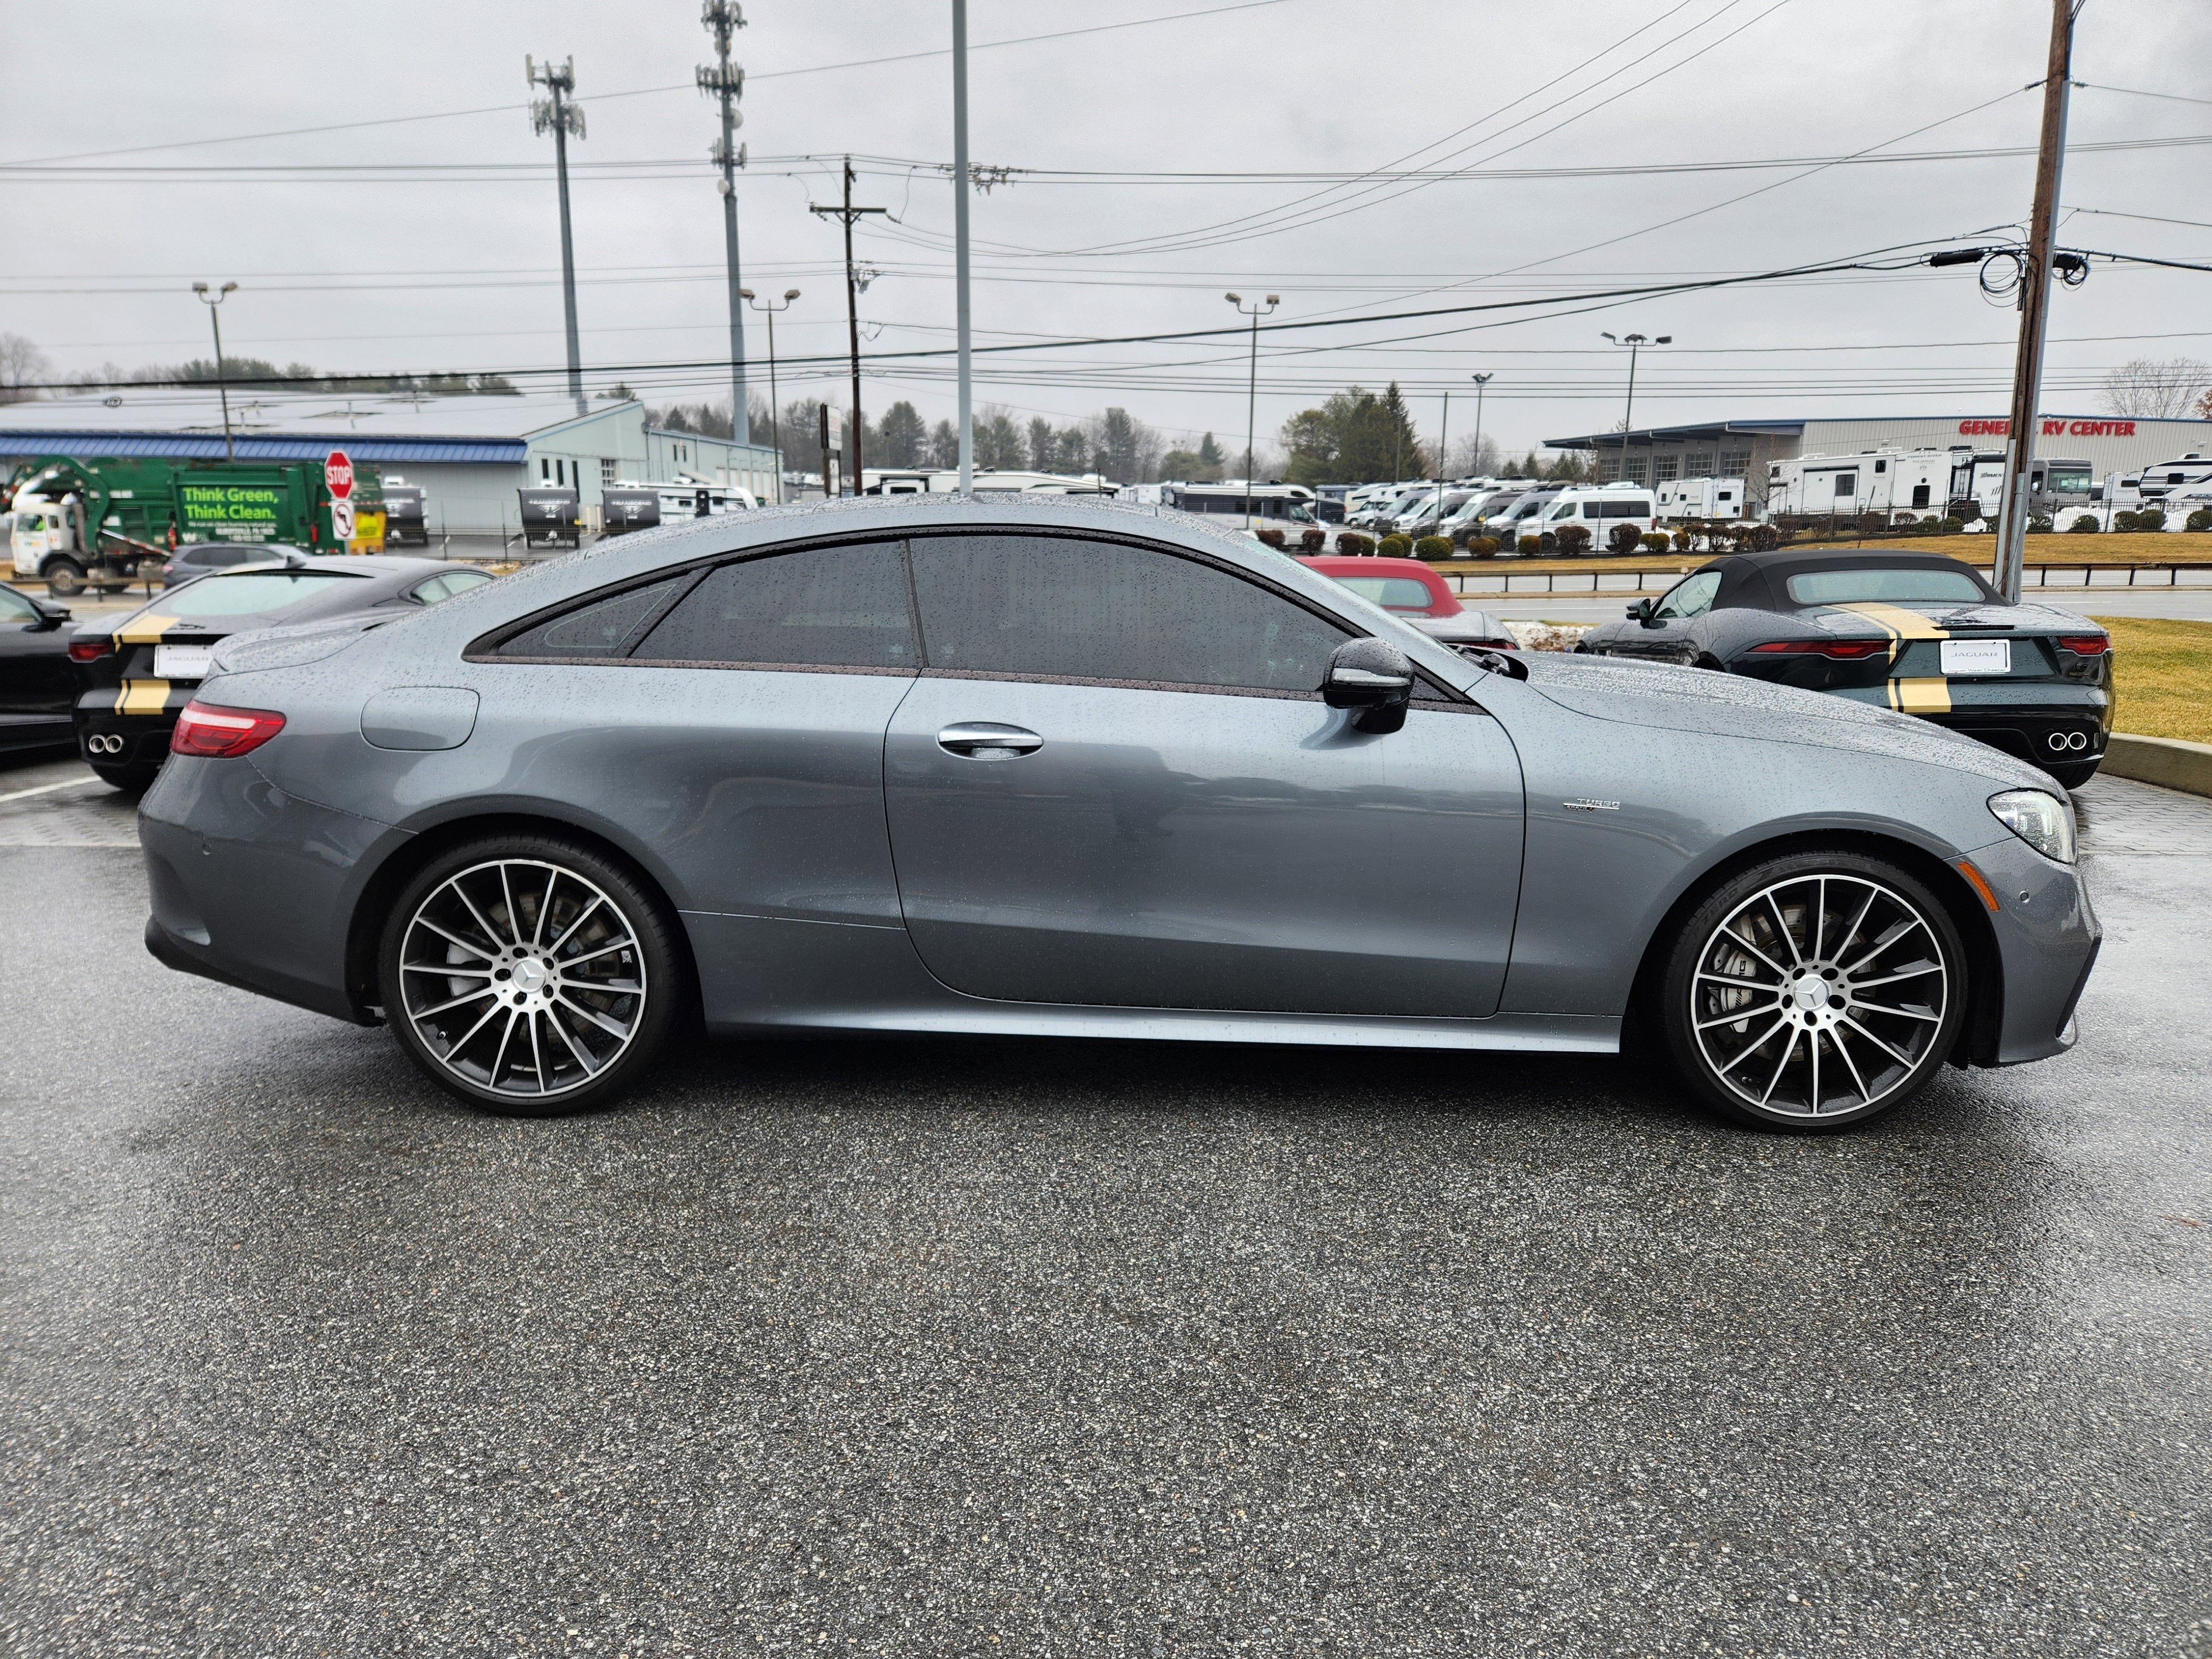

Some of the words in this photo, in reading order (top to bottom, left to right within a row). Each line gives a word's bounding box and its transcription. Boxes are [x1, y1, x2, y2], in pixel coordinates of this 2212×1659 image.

[1959, 420, 2038, 435] GENE
[2043, 421, 2067, 435] RV
[2070, 421, 2136, 436] CENTER
[326, 466, 351, 484] STOP
[183, 487, 226, 502] Think
[227, 487, 279, 504] Green,
[184, 504, 227, 519] Think
[228, 504, 276, 519] Clean.
[1577, 798, 1620, 808] TURBO
